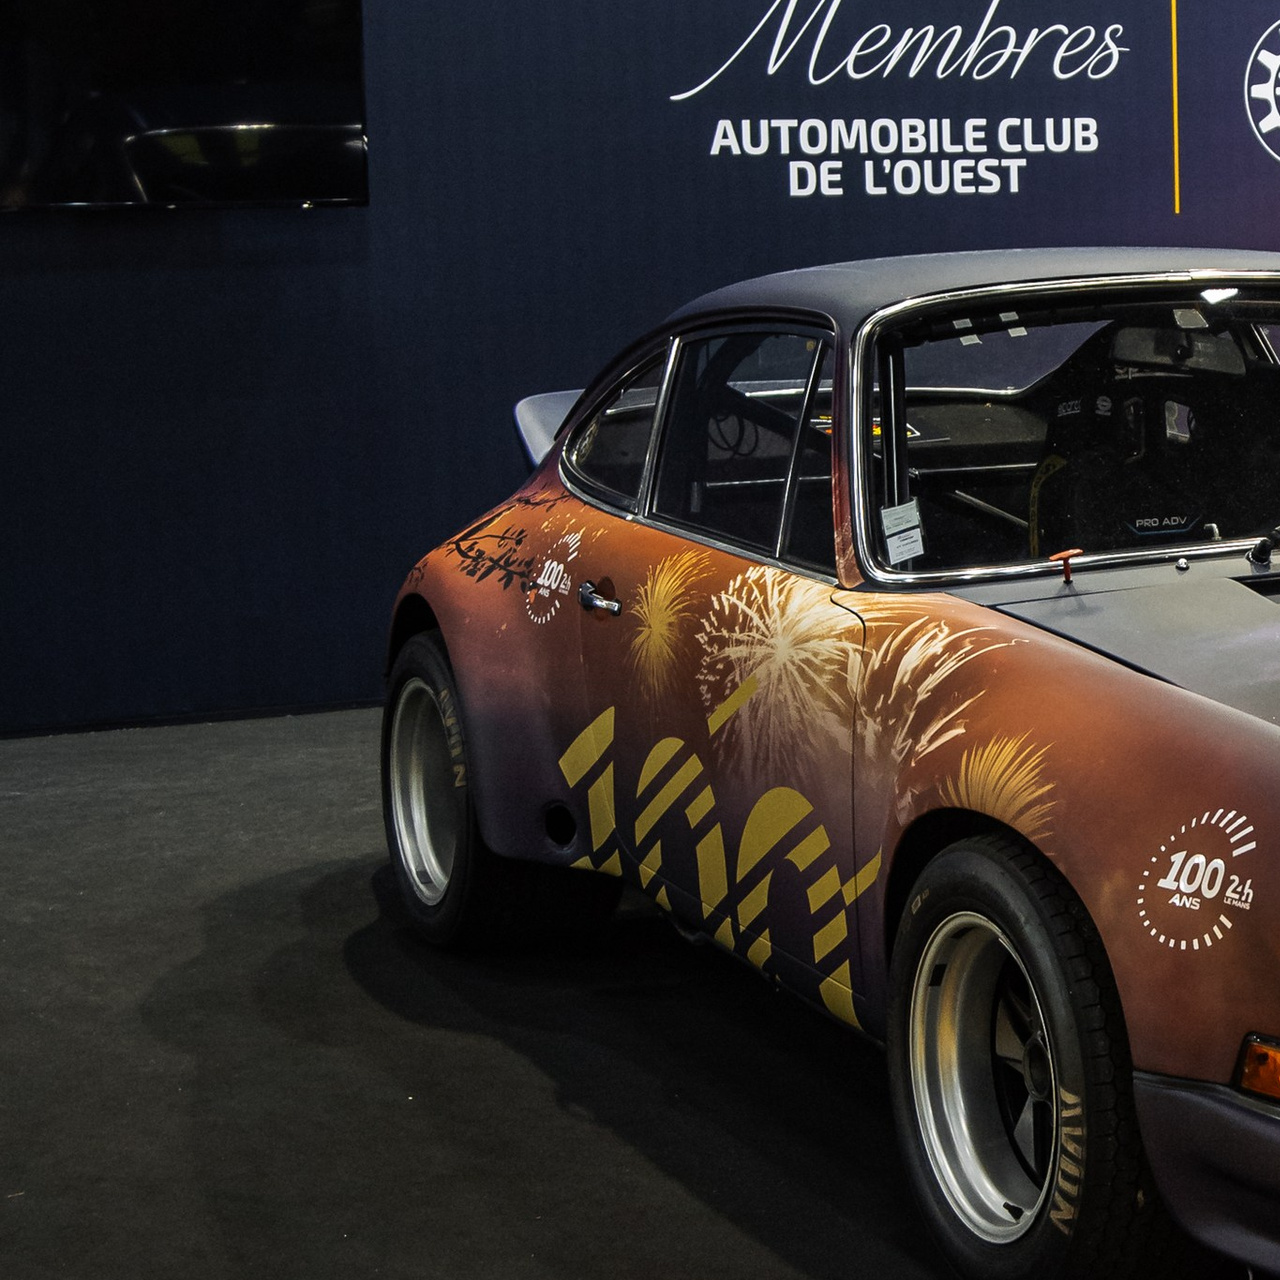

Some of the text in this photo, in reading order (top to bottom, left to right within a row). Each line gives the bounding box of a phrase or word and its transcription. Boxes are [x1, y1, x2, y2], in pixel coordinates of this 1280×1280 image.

[710, 117, 1099, 155] AUTOMOBILE CLUB
[788, 158, 1027, 196] DE L'OUEST
[1136, 516, 1187, 527] PRO ADV
[537, 559, 564, 590] 100
[1157, 851, 1253, 902] 100 24h
[1168, 893, 1201, 910] ANS
[1224, 897, 1250, 910] LE MANS
[1050, 1087, 1083, 1236] AVON
